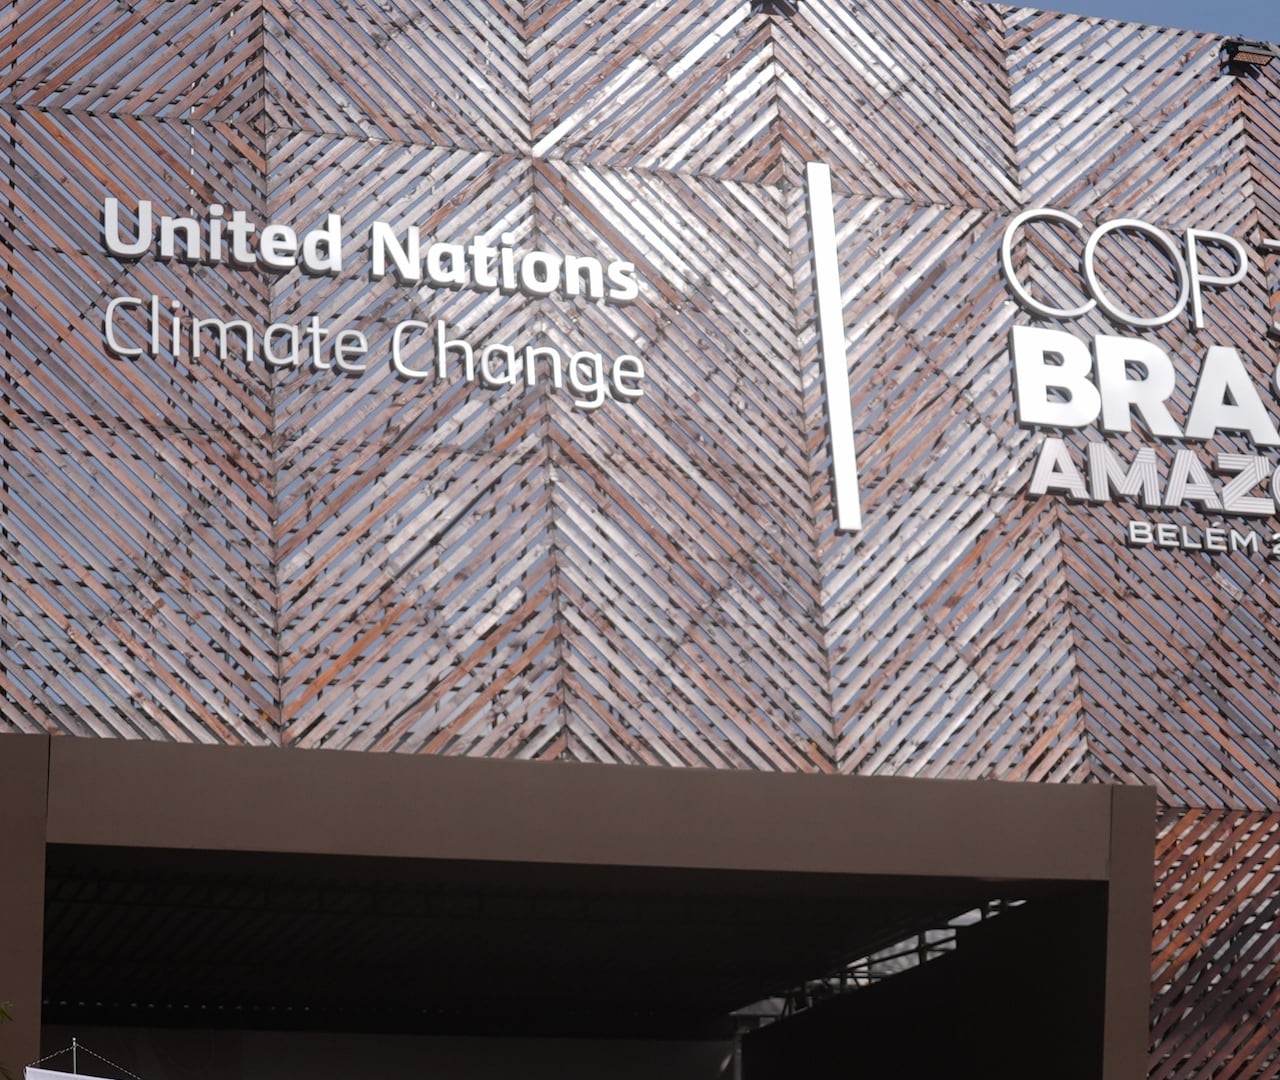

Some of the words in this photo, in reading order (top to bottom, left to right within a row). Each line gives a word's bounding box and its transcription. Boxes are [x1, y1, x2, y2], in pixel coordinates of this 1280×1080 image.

[103, 197, 343, 273] United
[372, 221, 641, 302] Nations
[104, 295, 368, 373] Climate
[392, 320, 645, 410] Change
[1128, 520, 1260, 554] BELÉM
